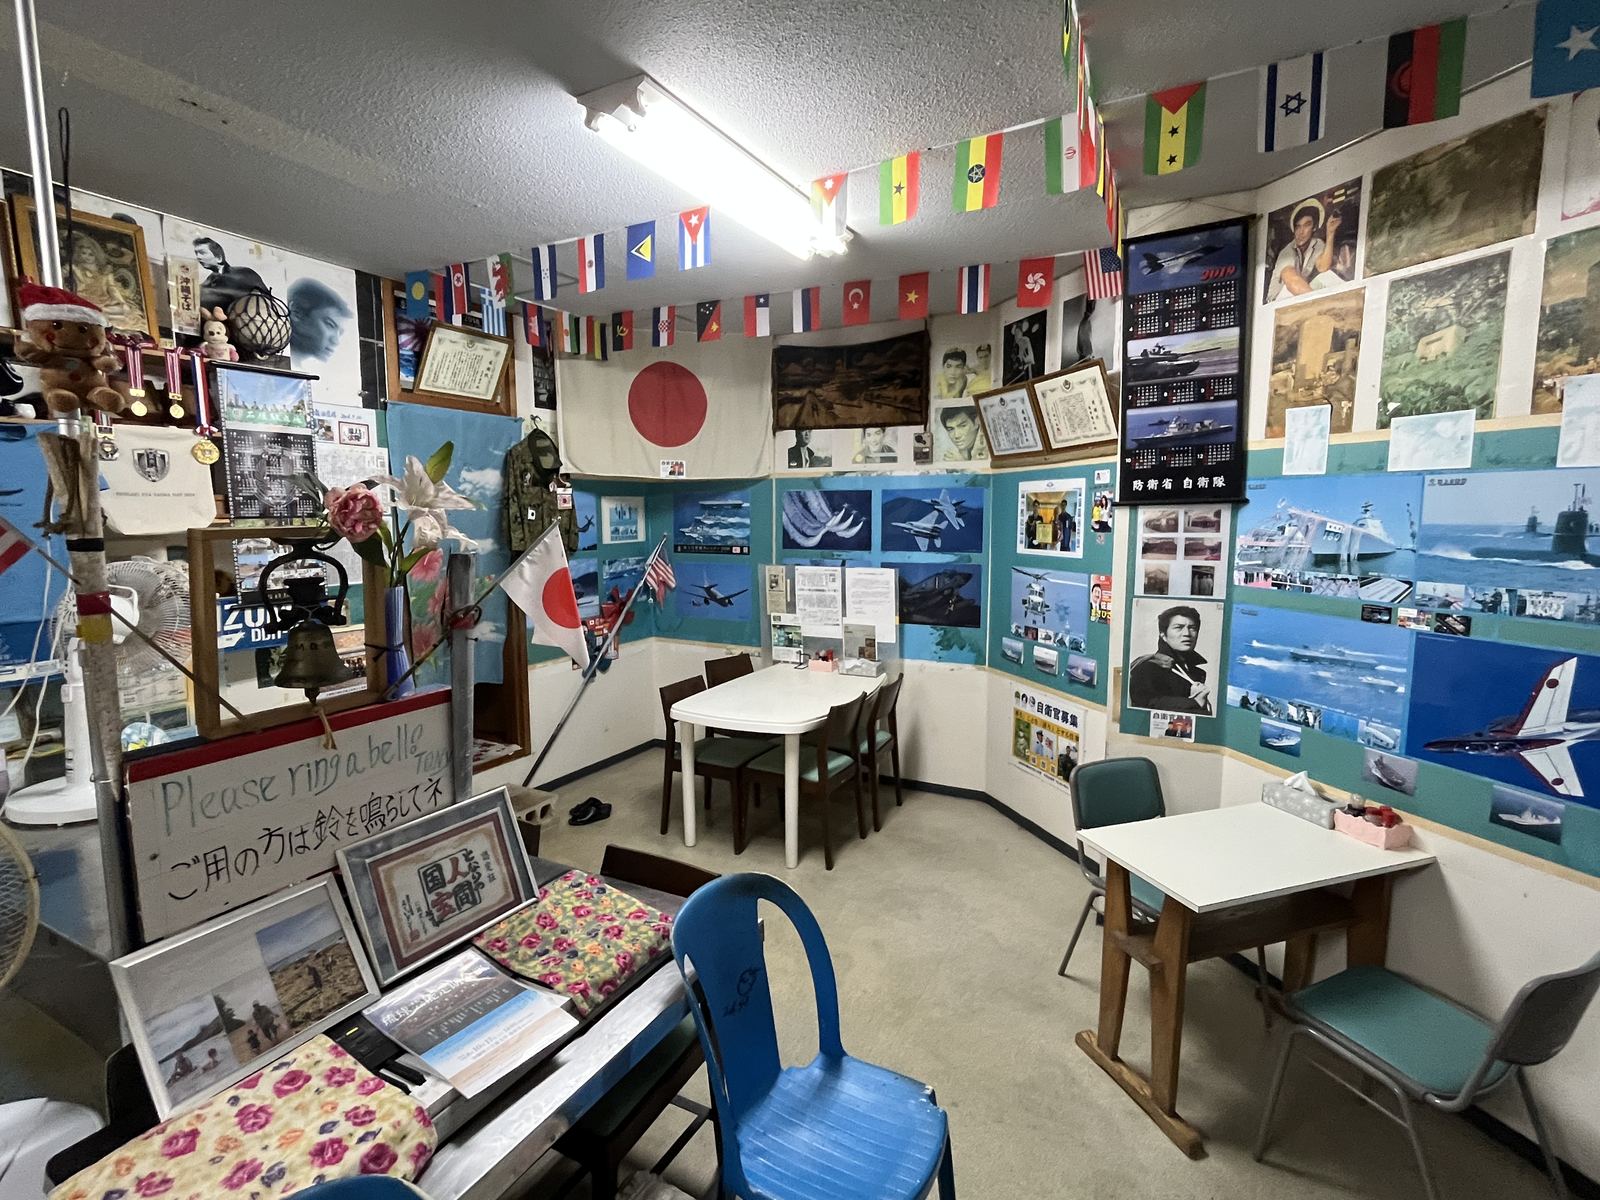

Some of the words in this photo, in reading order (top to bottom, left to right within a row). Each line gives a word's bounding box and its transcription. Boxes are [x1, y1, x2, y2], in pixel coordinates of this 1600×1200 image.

[1132, 478, 1173, 491] 防衛省
[1183, 475, 1226, 489] 自衛隊
[1037, 701, 1079, 728] 自衛官募集
[161, 775, 280, 837] Please
[288, 753, 340, 797] ring
[346, 751, 366, 777] a
[168, 777, 442, 900] ご用の方は鈴を鳴らしてネ
